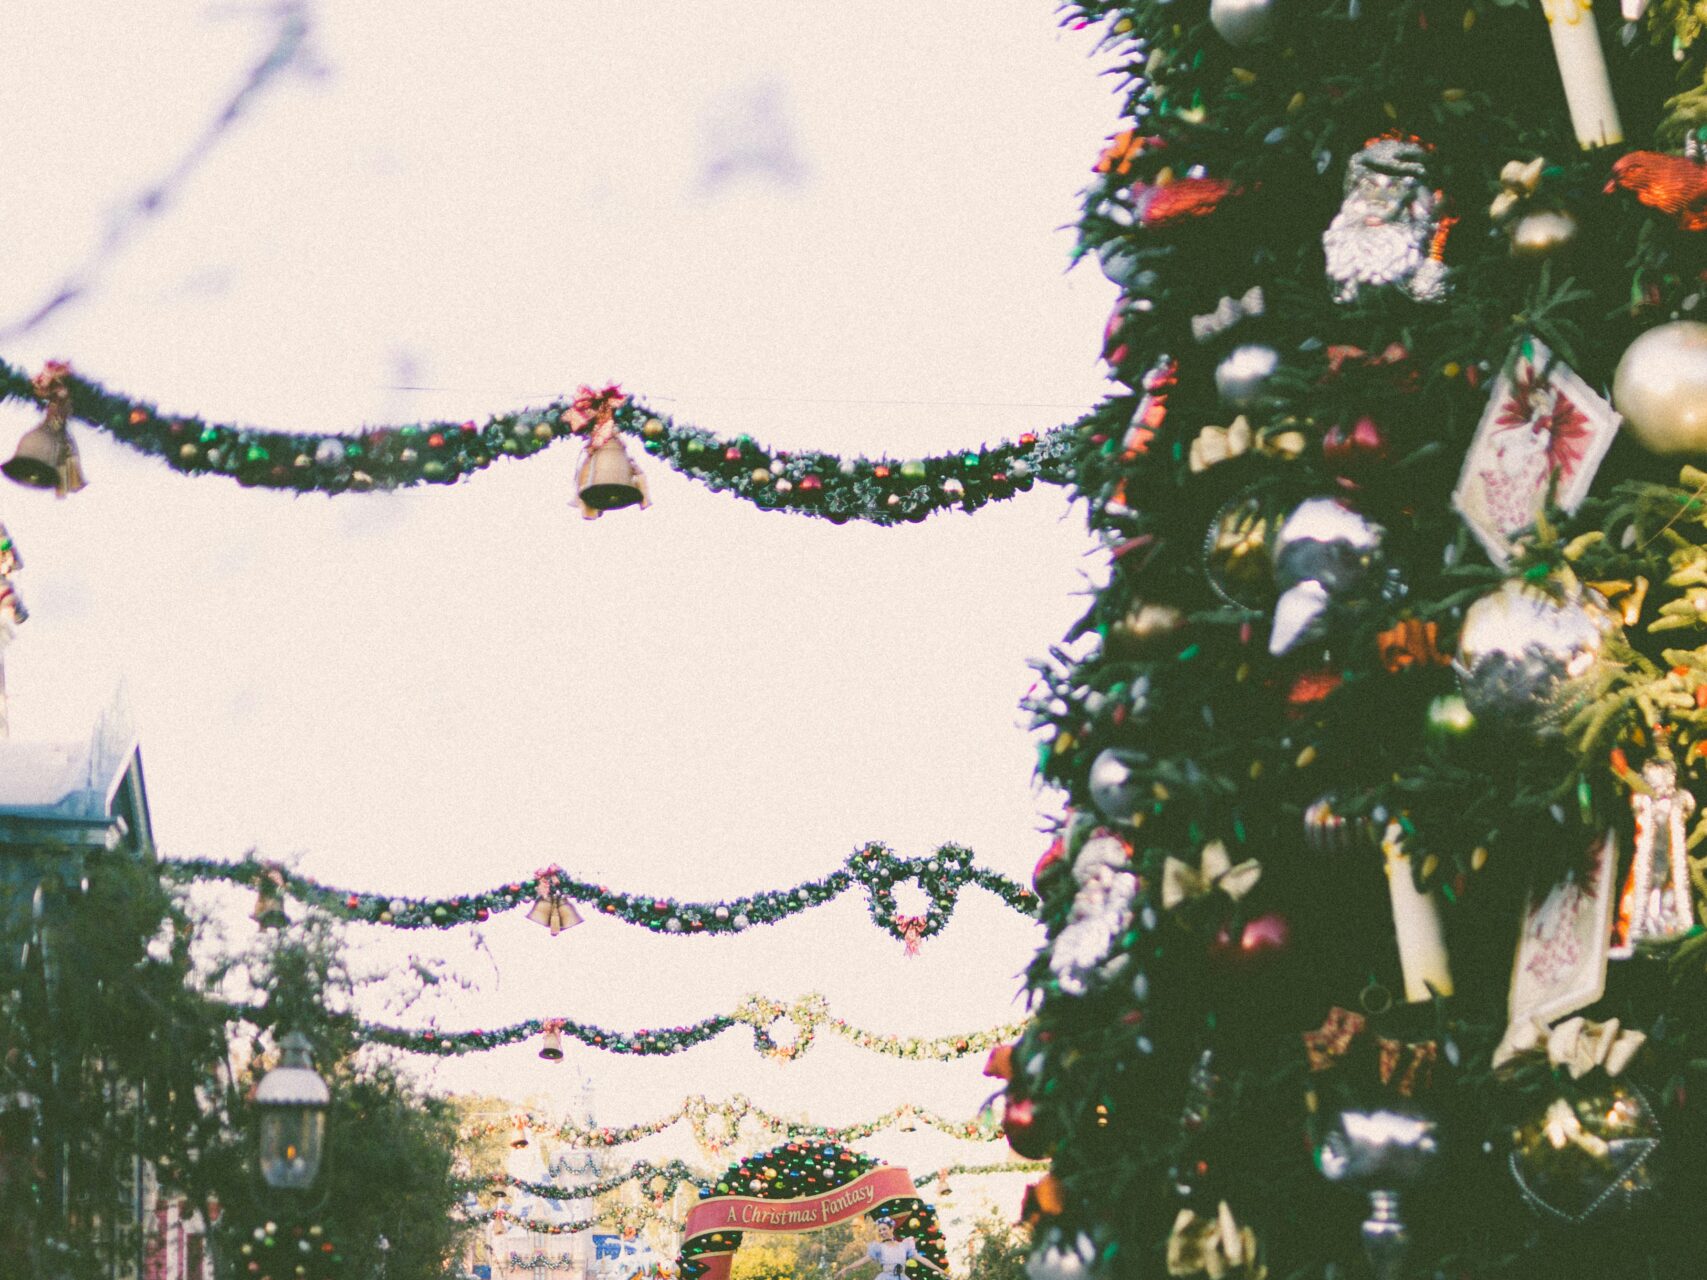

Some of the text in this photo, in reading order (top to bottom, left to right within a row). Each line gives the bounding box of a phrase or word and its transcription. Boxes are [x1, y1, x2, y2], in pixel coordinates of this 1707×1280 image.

[727, 1184, 875, 1225] A Christmas Fantasy
